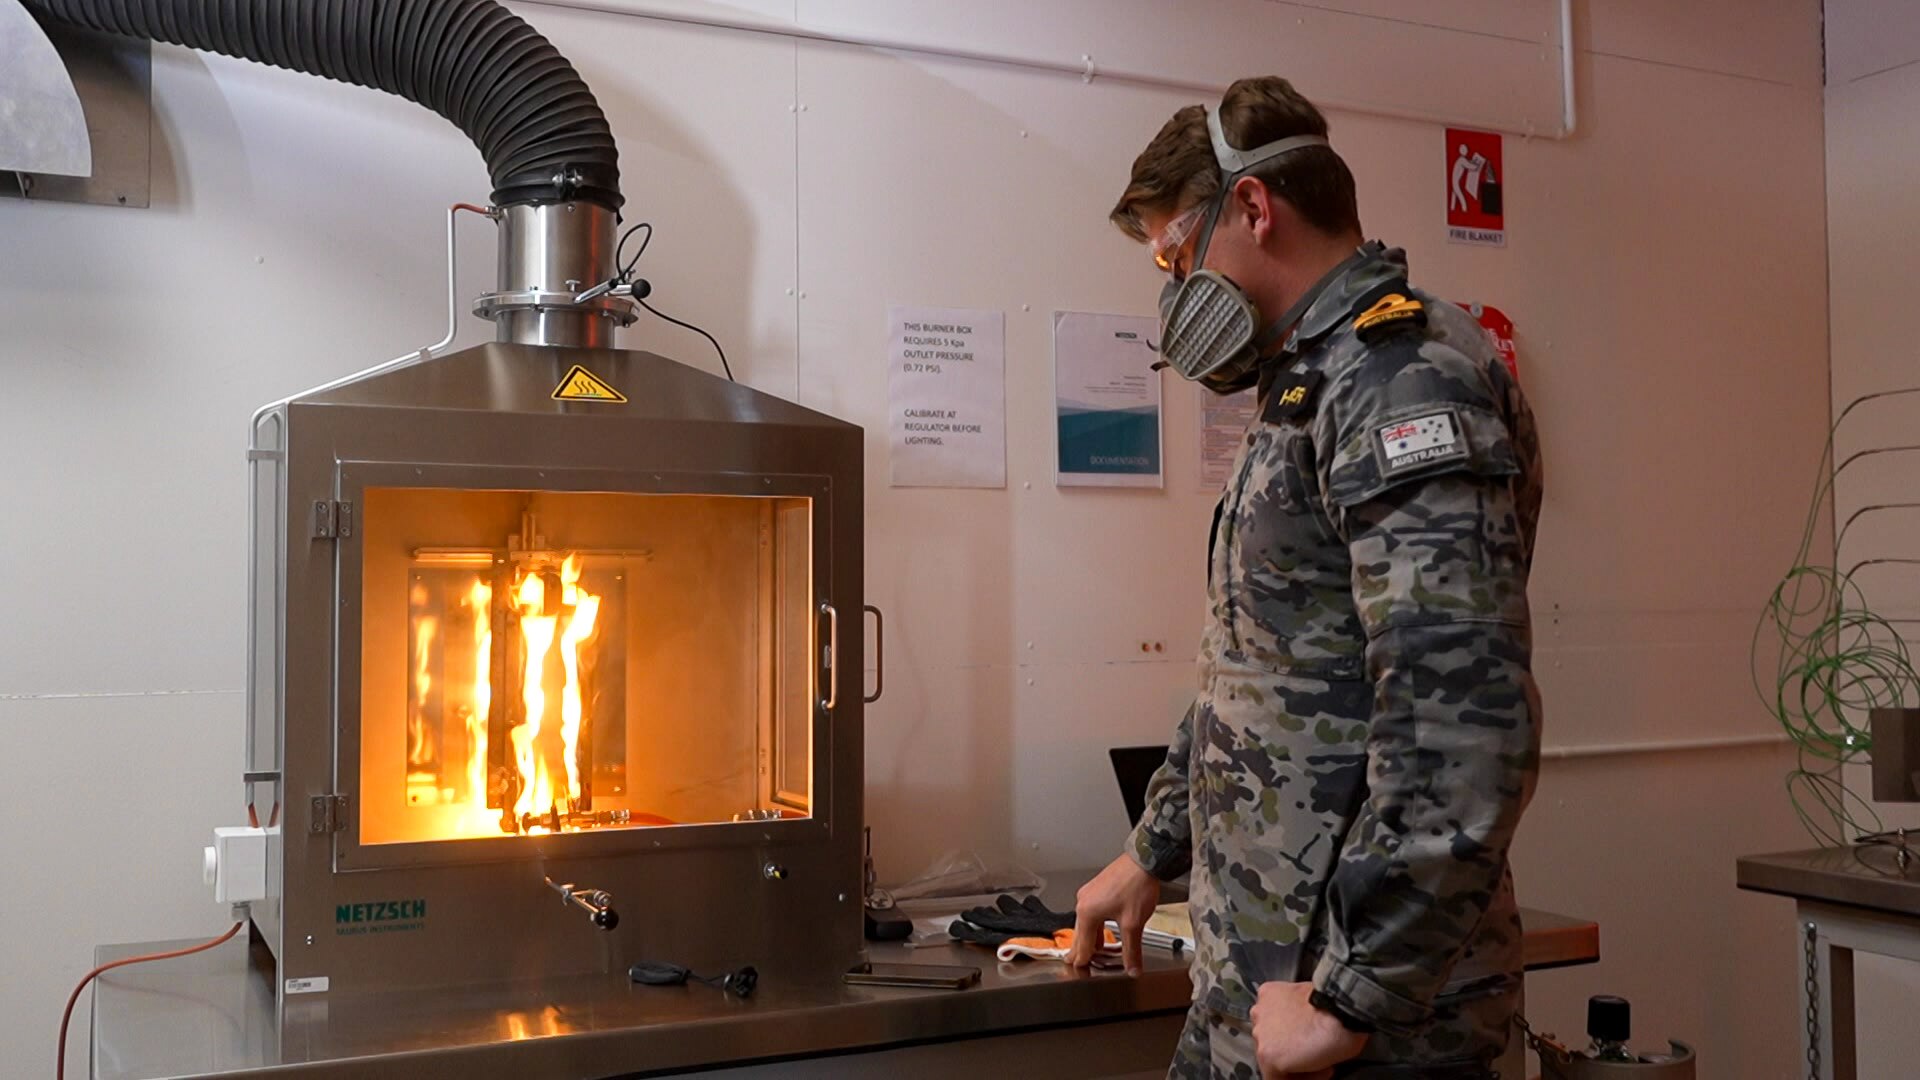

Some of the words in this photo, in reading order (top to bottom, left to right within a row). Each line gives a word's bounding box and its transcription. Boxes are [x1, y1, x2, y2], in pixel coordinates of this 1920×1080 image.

[1449, 229, 1467, 240] FIRE
[1468, 231, 1503, 243] BLANKET
[1362, 310, 1415, 328] AUSTRALIA
[903, 322, 921, 332] THIS
[922, 324, 956, 333] BURNER
[956, 326, 973, 334] BOX
[903, 336, 943, 346] REQUIRES
[943, 338, 950, 347] 5
[951, 338, 966, 348] Kpa
[903, 350, 934, 359] OUTLET
[935, 352, 974, 361] PRESSURE
[903, 363, 924, 373] (0.72
[904, 408, 945, 418] CALIBRATE
[947, 410, 957, 418] AT
[904, 423, 951, 432] REGULATOR
[952, 425, 982, 434] BEFORE
[904, 437, 945, 446] LIGHTING.
[1391, 445, 1454, 469] AUSTRALIA
[335, 899, 426, 923] NETZSCH
